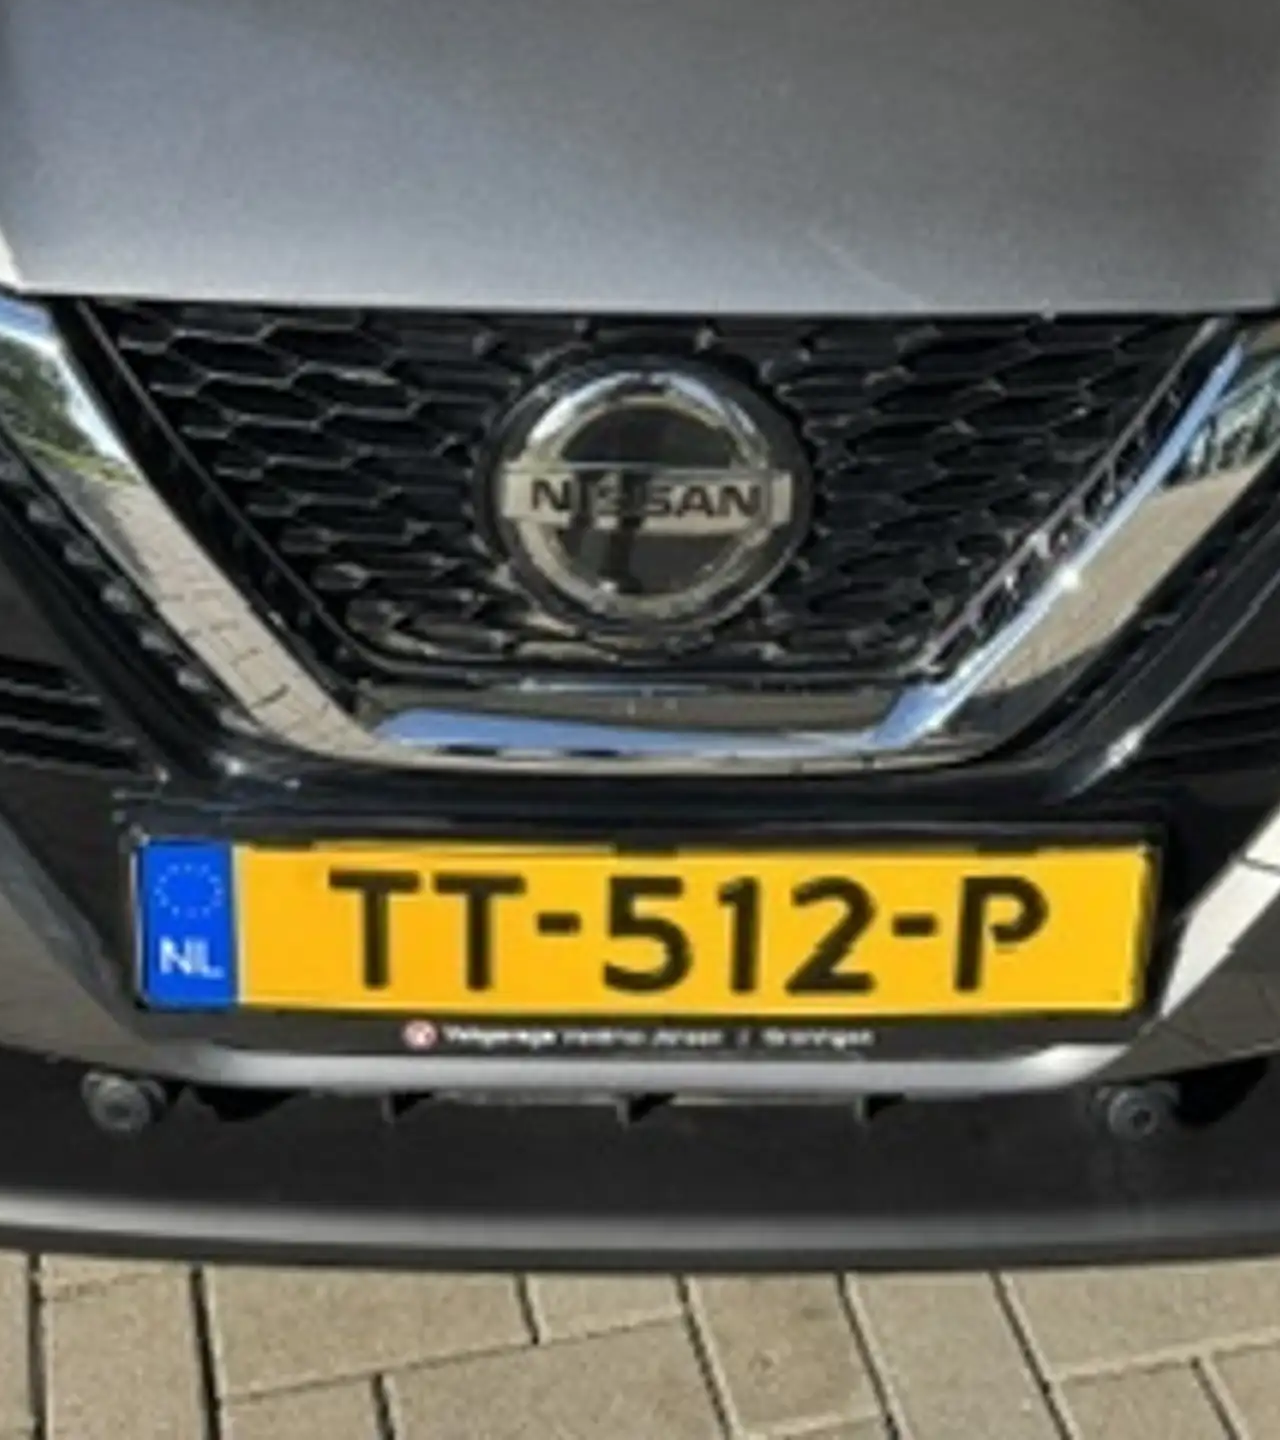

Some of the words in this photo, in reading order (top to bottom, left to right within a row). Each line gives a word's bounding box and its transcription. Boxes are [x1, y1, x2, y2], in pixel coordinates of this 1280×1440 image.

[529, 476, 764, 520] NISSAN
[327, 868, 1051, 994] TT-512-P
[158, 934, 226, 980] NL
